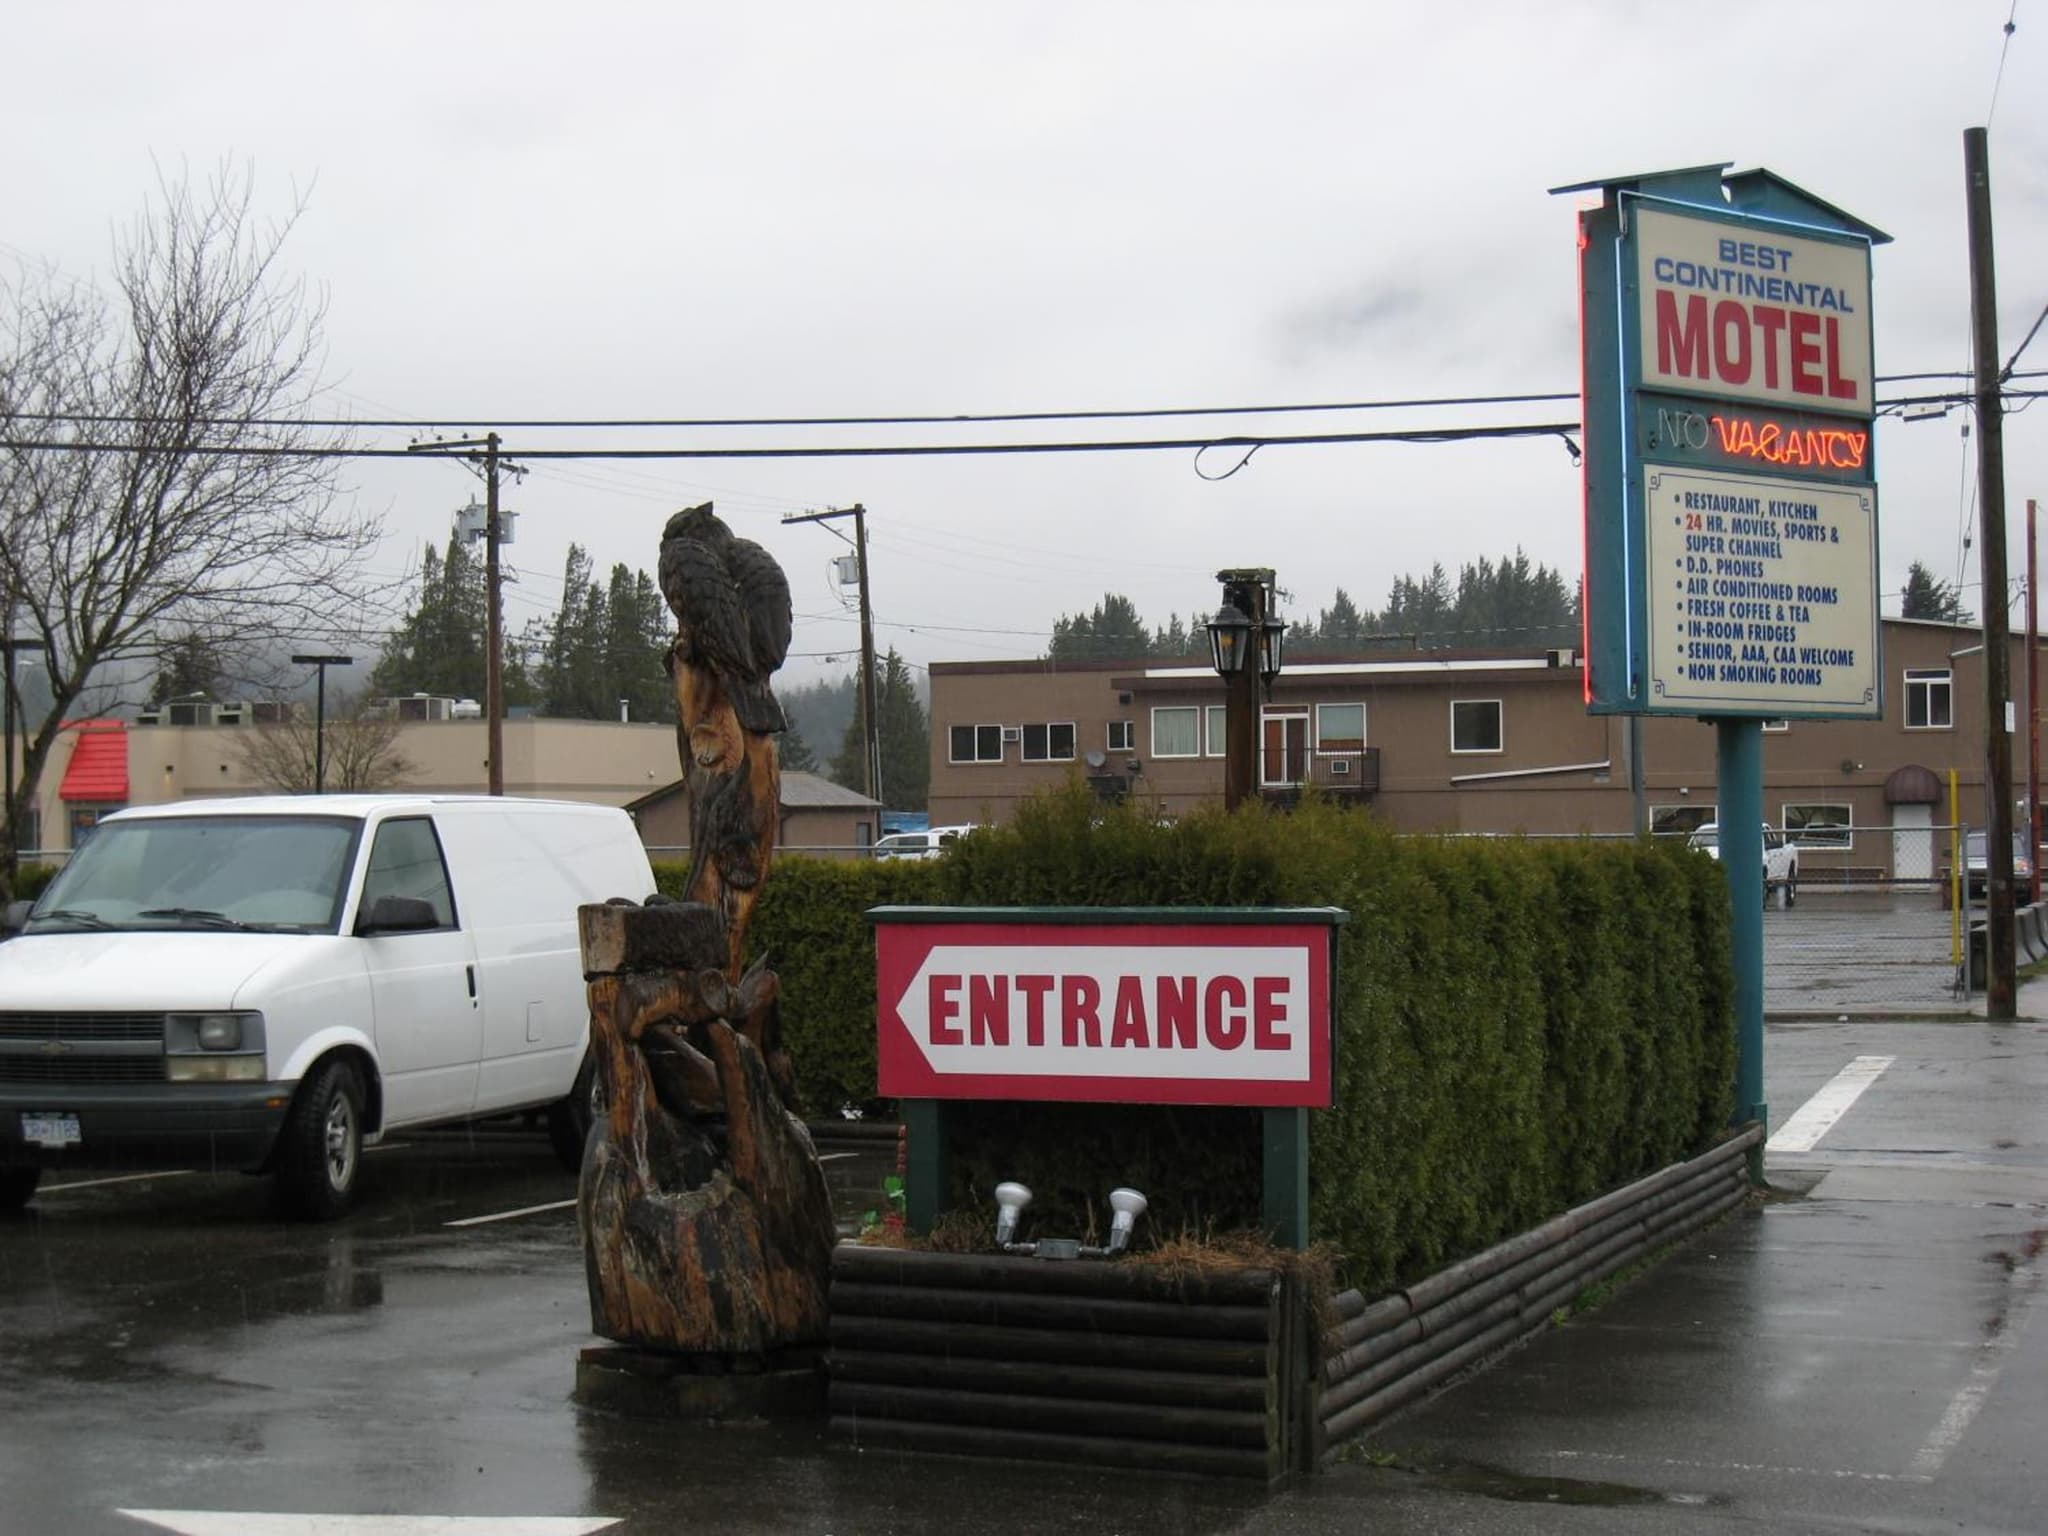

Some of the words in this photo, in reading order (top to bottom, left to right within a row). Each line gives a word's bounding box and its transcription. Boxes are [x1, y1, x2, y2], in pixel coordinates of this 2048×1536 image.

[1719, 238, 1792, 272] BEST
[1654, 258, 1854, 313] CONTINENTAL
[1656, 289, 1857, 400] MOTEL
[1658, 408, 1708, 448] NO
[1712, 416, 1866, 468] VACANCY
[1685, 492, 1765, 518] RESTAURANT,
[1769, 500, 1817, 521] KITCHEN
[1685, 513, 1702, 531] 24
[1707, 516, 1727, 534] HR.
[1732, 518, 1780, 539] MOVIES,
[1784, 523, 1826, 542] SPORTS
[1830, 527, 1839, 543] &
[1686, 535, 1724, 553] SUPER
[1729, 539, 1782, 559] CHANNEL
[1687, 557, 1712, 574] D.D.
[1717, 559, 1763, 578] PHONES
[1687, 578, 1708, 595] AIR
[1713, 579, 1793, 601] CONDITIONED
[1797, 586, 1837, 604] ROOMS
[1688, 599, 1724, 618] FRESH
[1730, 602, 1771, 620] COFFEE
[1776, 606, 1785, 621] &
[1789, 606, 1809, 623] TEA
[1688, 621, 1744, 640] IN-ROOM
[1748, 624, 1796, 642] FRIDGES
[1688, 642, 1736, 663] SENIOR,
[1741, 646, 1769, 664] AAA,
[1774, 646, 1796, 664] CAA
[1800, 648, 1854, 666] WELCOME
[1688, 664, 1715, 681] NON
[1720, 666, 1776, 683] SMOKING
[1780, 668, 1822, 685] ROOMS
[929, 974, 1291, 1051] ENTRANCE
